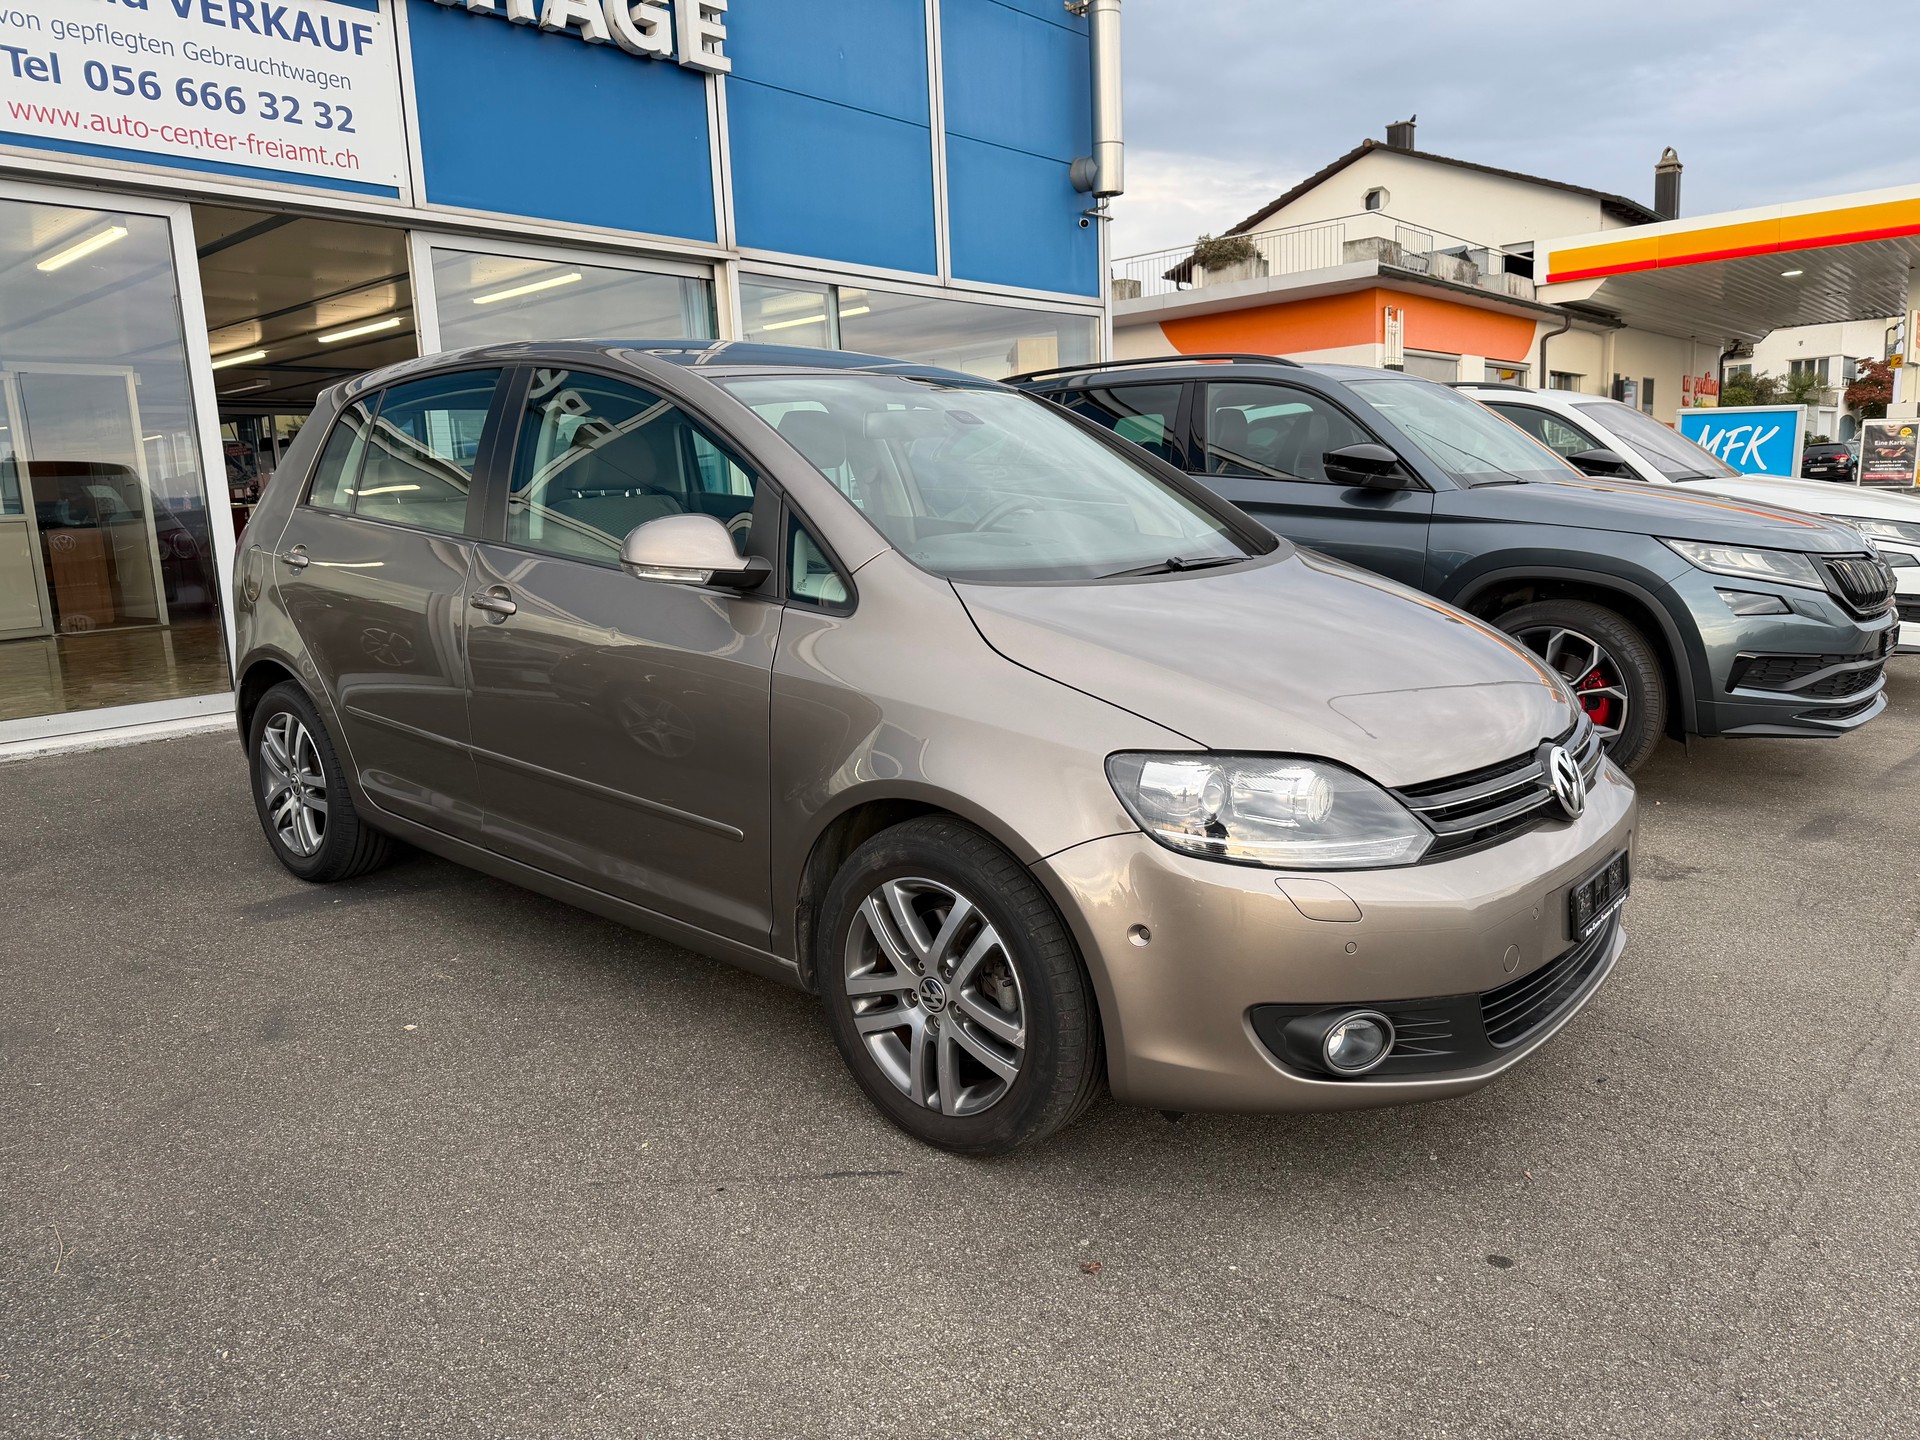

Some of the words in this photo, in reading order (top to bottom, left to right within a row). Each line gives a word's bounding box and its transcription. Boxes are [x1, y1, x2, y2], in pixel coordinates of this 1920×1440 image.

[51, 18, 175, 57] gepflegten
[183, 41, 352, 90] Gebrauchtwagen
[170, 0, 373, 56] VERKAUF
[0, 44, 62, 84] Tel
[84, 60, 162, 100] 056
[175, 77, 246, 115] 666
[258, 91, 303, 125] 32
[313, 101, 356, 134] 32
[7, 101, 360, 170] www.auto-center-freiamt.ch
[1697, 424, 1780, 470] MFK
